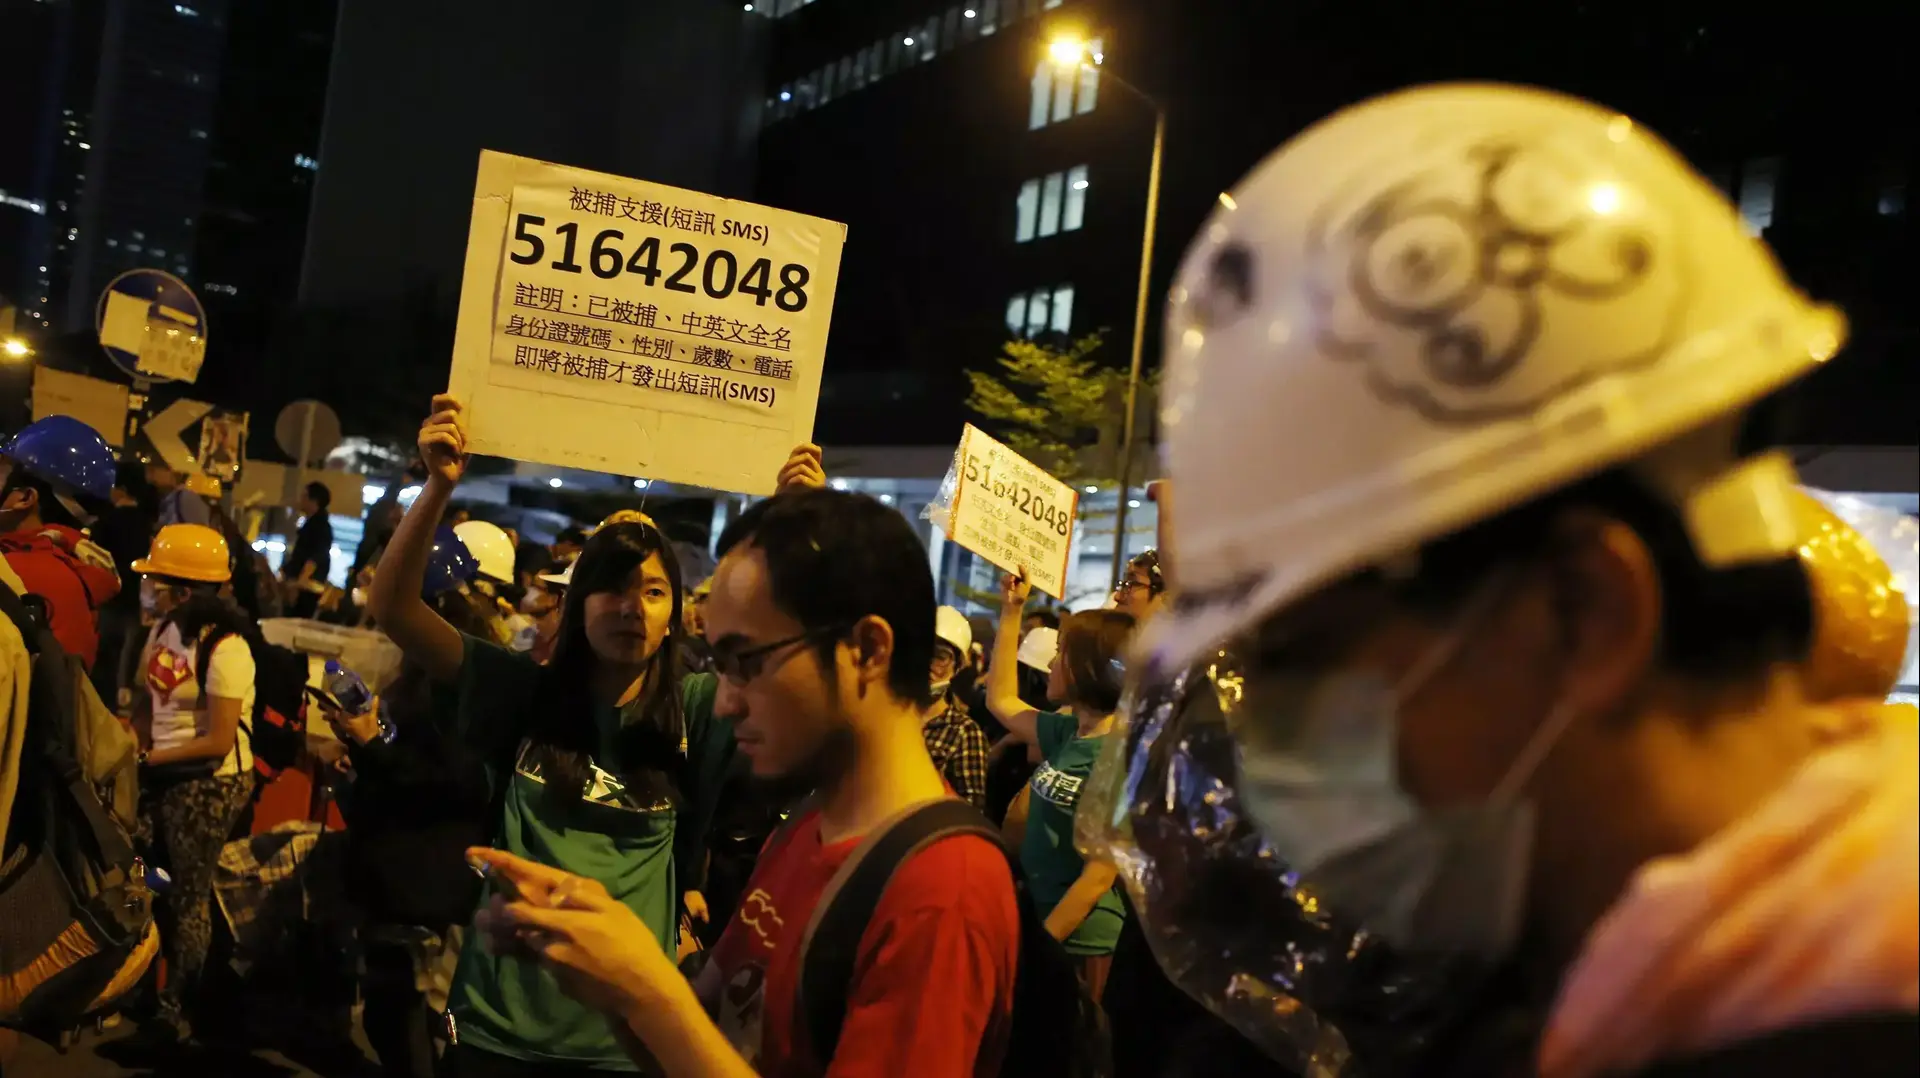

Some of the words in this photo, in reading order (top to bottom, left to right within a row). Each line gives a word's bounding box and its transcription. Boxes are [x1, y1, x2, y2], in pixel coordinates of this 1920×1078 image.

[569, 187, 716, 236] 被捕支援(短訊
[721, 219, 770, 246] SMS)
[510, 213, 810, 312] 51642048
[966, 454, 1068, 537] 51642048
